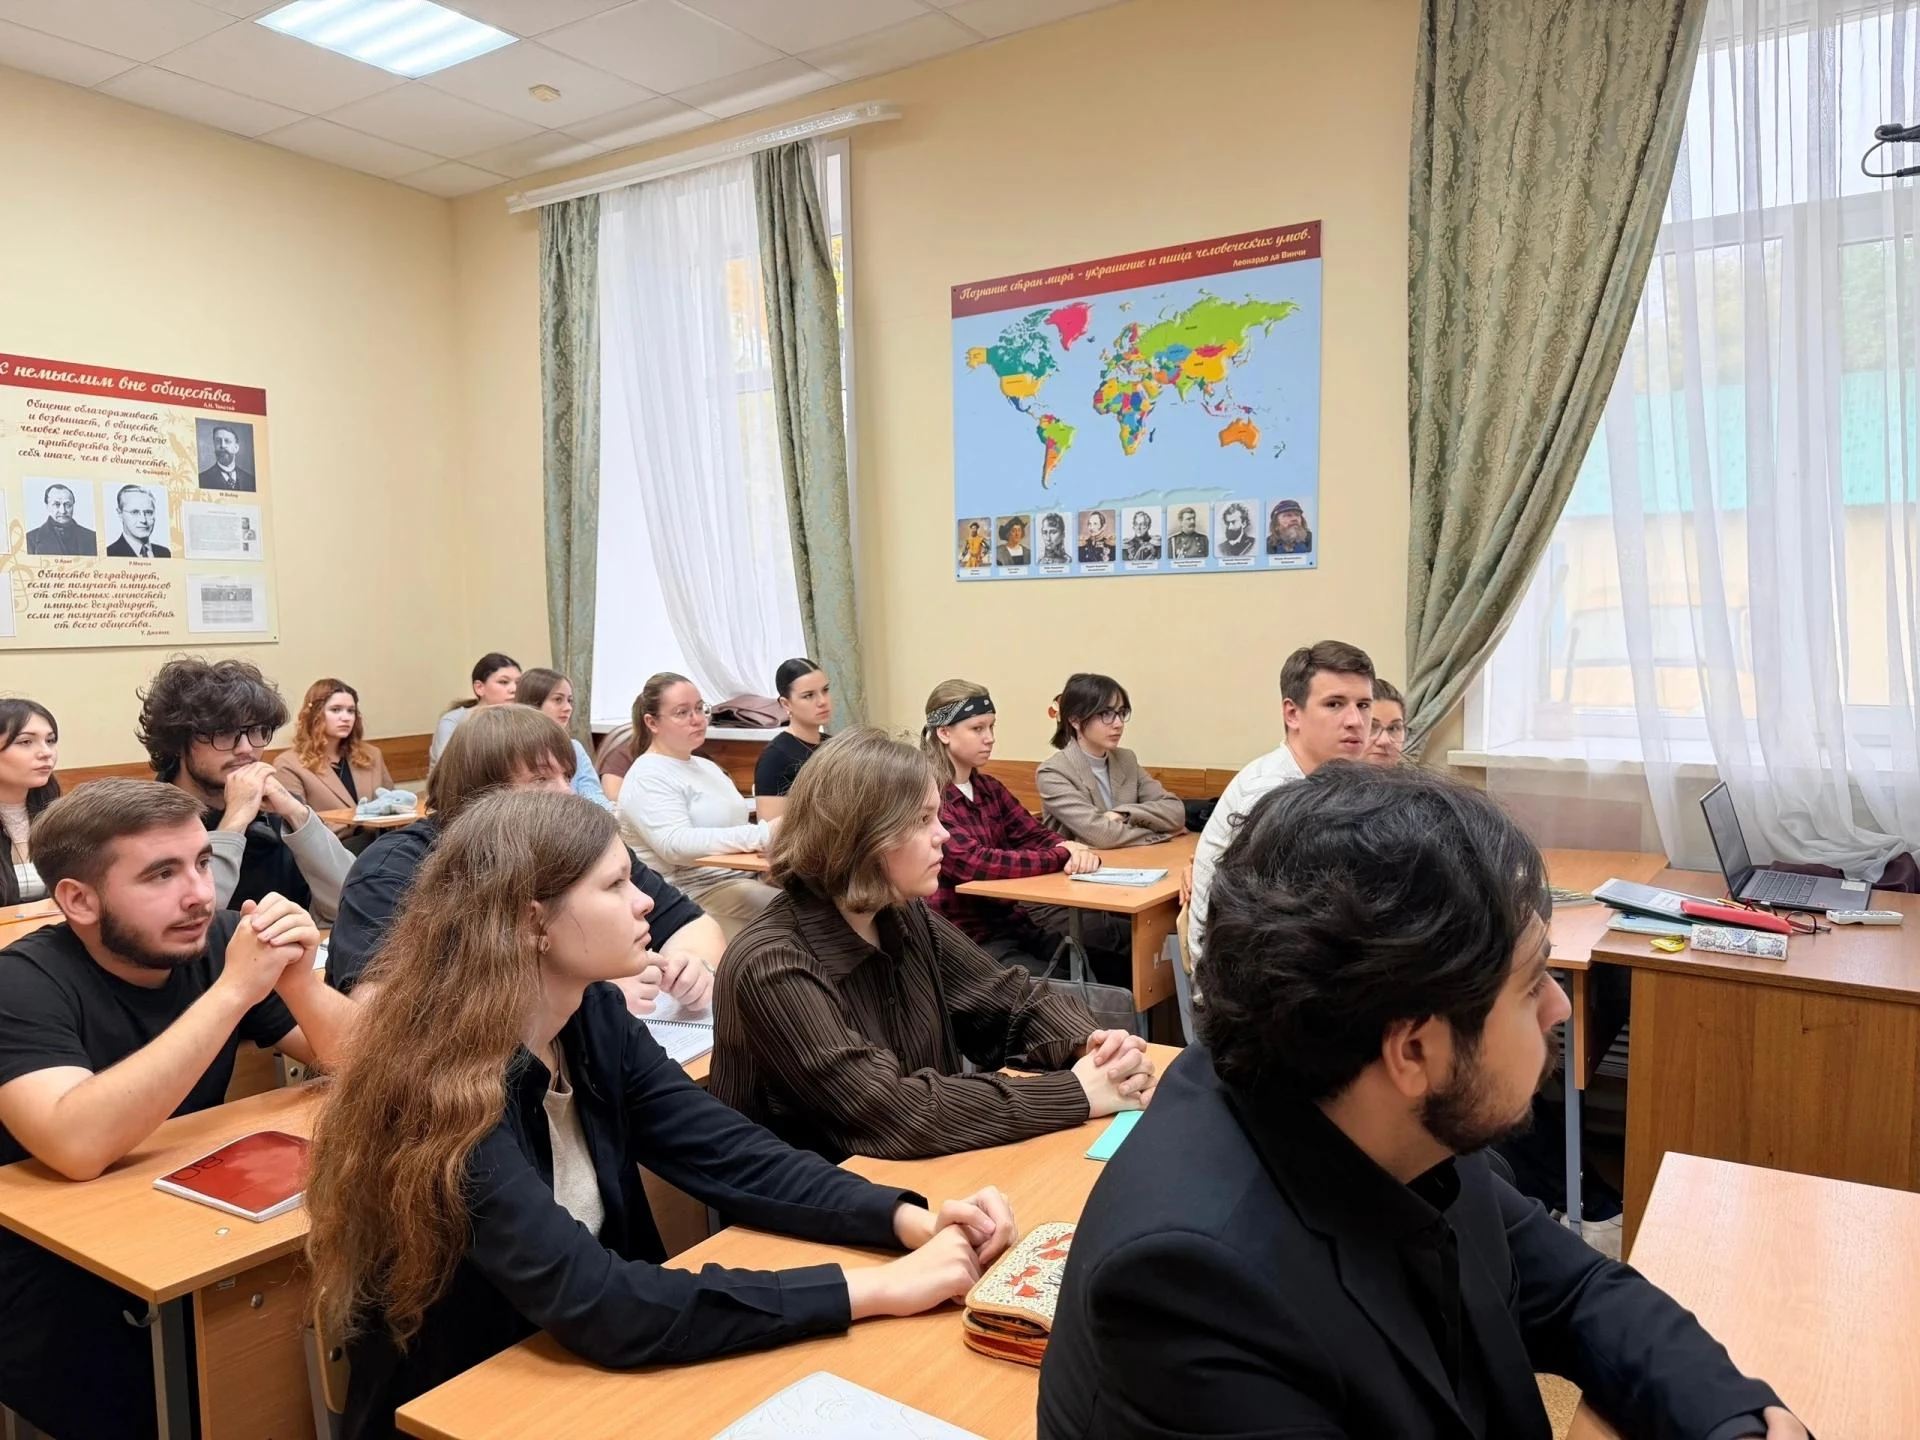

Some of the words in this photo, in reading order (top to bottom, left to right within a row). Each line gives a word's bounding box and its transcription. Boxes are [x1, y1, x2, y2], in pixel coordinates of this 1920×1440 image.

[960, 284, 1008, 301] Познание
[1010, 279, 1042, 293] стран
[1044, 272, 1074, 286] мира
[1085, 260, 1146, 281] украшение
[1148, 257, 1157, 267] и
[1158, 251, 1192, 264] пища
[1196, 236, 1273, 258] человеческих
[1275, 228, 1311, 248] умов.
[1232, 255, 1269, 267] Леонардо
[1270, 253, 1280, 262] да
[1281, 249, 1306, 259] Винчи
[14, 366, 115, 388] немыслим
[118, 376, 148, 392] вне
[151, 380, 236, 405] общества.
[26, 398, 71, 412] Общение
[74, 404, 159, 420] облагораживает
[28, 413, 35, 421] и
[38, 412, 100, 428] возвышает,
[104, 420, 111, 428] в
[20, 425, 61, 436] человек
[63, 428, 110, 441] невольно,
[113, 431, 128, 444] без
[130, 434, 167, 445] всякого
[38, 438, 109, 452] притворства
[112, 442, 152, 455] держит
[18, 447, 41, 458] себя
[43, 451, 76, 461] иначе,
[80, 454, 99, 462] чем
[101, 454, 108, 462] в
[110, 454, 171, 468] одиночестве.
[37, 569, 91, 581] Общество
[93, 569, 160, 582] деградирует,
[67, 580, 117, 591] получает
[120, 581, 171, 592] импульсов
[33, 590, 49, 599] от
[51, 589, 110, 599] отдельных
[111, 591, 167, 600] личностей;
[43, 602, 89, 611] импульс
[91, 599, 158, 612] деградирует,
[26, 612, 50, 620] если
[52, 612, 65, 620] не
[67, 610, 117, 621] получает
[119, 610, 175, 621] сочувствия
[54, 620, 69, 629] от
[72, 620, 98, 629] всего
[100, 619, 152, 631] общества.
